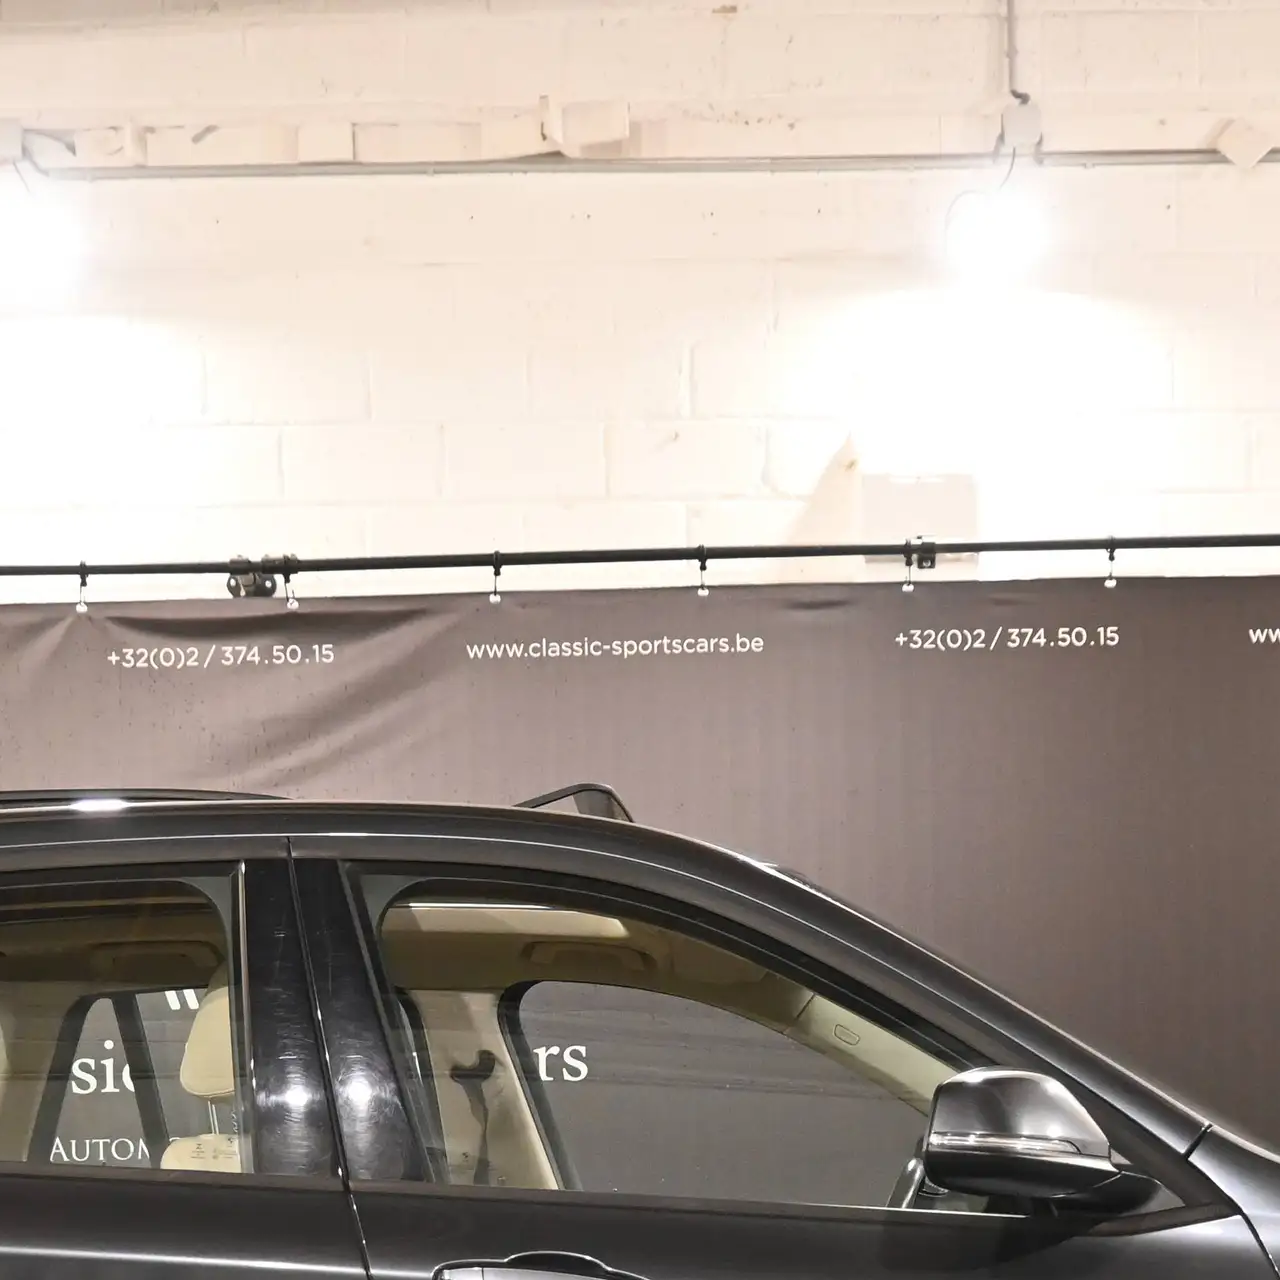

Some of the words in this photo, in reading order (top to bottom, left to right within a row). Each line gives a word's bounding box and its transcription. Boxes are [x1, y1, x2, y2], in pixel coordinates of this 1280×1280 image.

[466, 632, 764, 659] www.classic-sportscars.be
[895, 628, 986, 652] +32(0)2
[1007, 626, 1120, 649] 374.50.15
[107, 645, 200, 669] +32(0)2
[221, 643, 335, 666] 374.50.15
